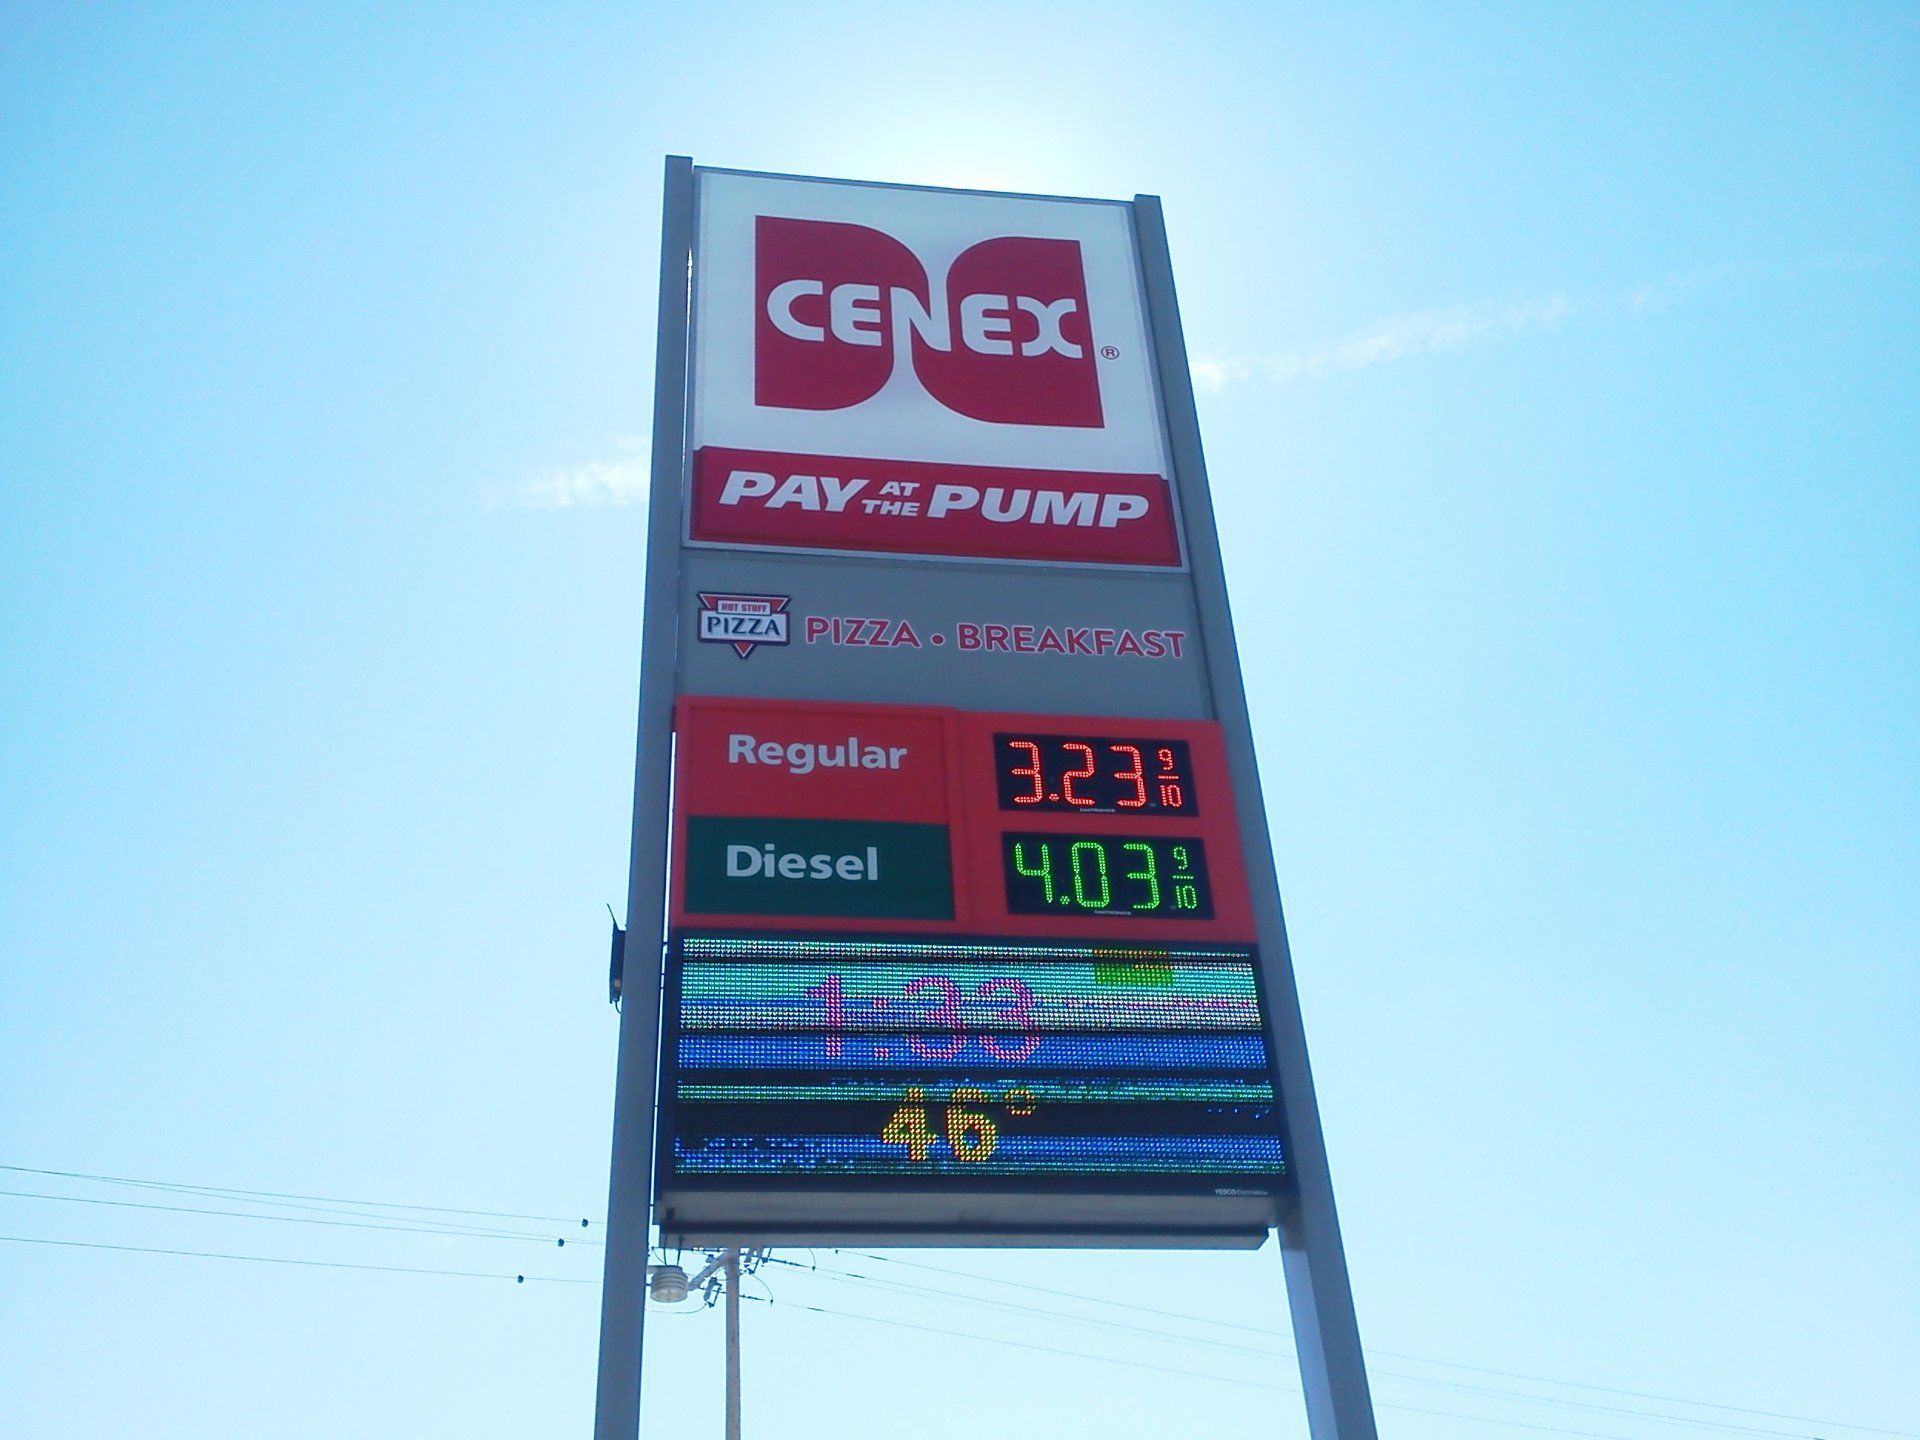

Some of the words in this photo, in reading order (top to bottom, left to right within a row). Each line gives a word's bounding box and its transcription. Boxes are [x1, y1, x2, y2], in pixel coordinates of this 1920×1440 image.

[766, 279, 1083, 360] CENEX
[718, 470, 870, 512] PAY
[861, 499, 918, 517] THE
[878, 480, 920, 497] AT
[926, 484, 1150, 528] PUMP
[707, 616, 781, 636] PIZZA
[721, 602, 738, 612] HOT
[741, 603, 767, 613] STUFF
[806, 615, 923, 649] PIZZA
[956, 622, 1187, 659] BREAKFAST
[727, 734, 908, 775] Regular
[1009, 741, 1147, 808] 3.23
[726, 842, 880, 882] Diesel
[1015, 842, 1160, 909] 4.03
[805, 972, 1041, 1062] 1:33
